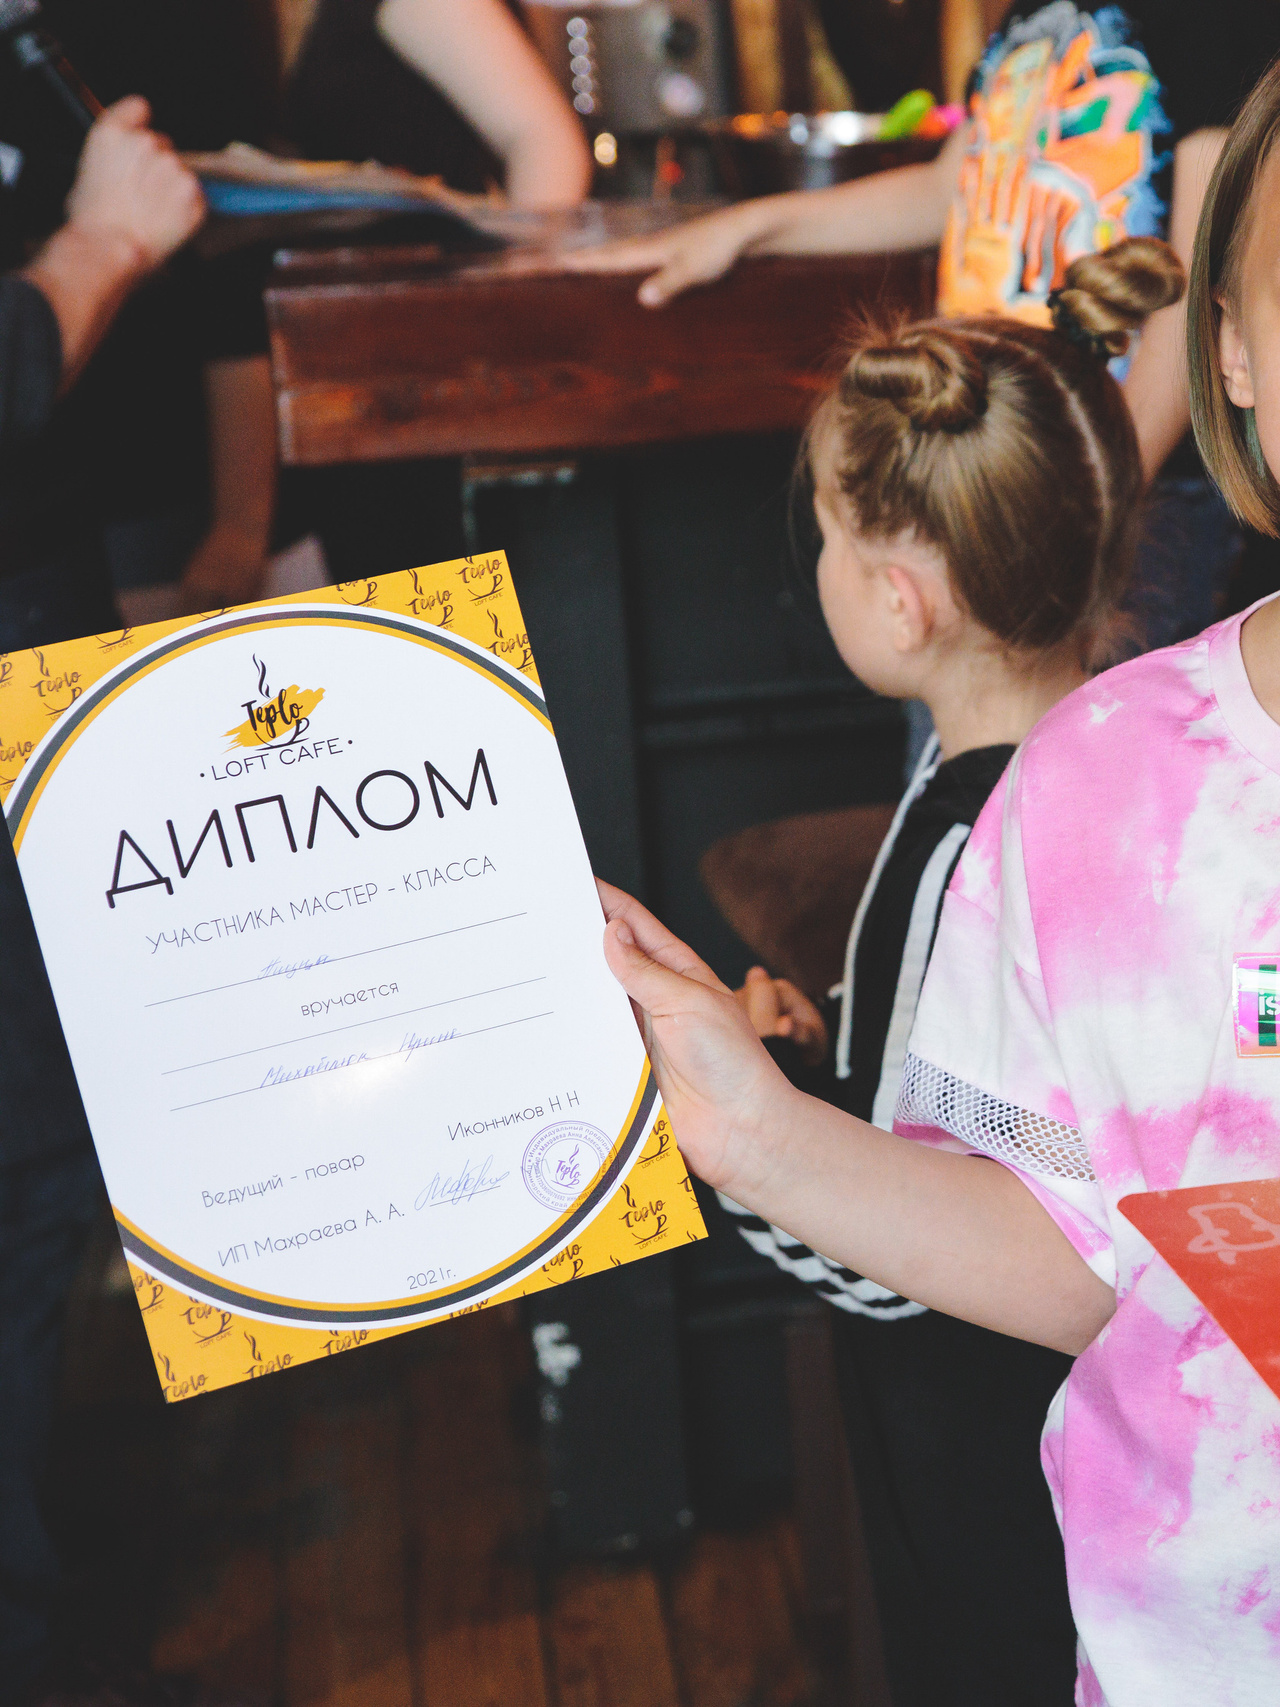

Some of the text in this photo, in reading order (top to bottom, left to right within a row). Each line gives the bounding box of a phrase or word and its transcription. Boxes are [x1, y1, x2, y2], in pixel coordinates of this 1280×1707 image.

[240, 688, 304, 739] Teplo
[211, 737, 344, 781] LOFT CAFE
[105, 748, 499, 909] ДИПЛОМ
[145, 905, 285, 955] УЧАСТНИКА
[289, 881, 379, 921] МАСТЕР
[401, 855, 497, 894] КЛАССА
[300, 982, 400, 1018] вручается
[447, 1104, 545, 1142] Иконников
[201, 1174, 284, 1208] Ведущий
[304, 1153, 366, 1182] повар
[217, 1202, 406, 1268] ИП Махраева А. А.
[406, 1267, 458, 1291] 2021г.
